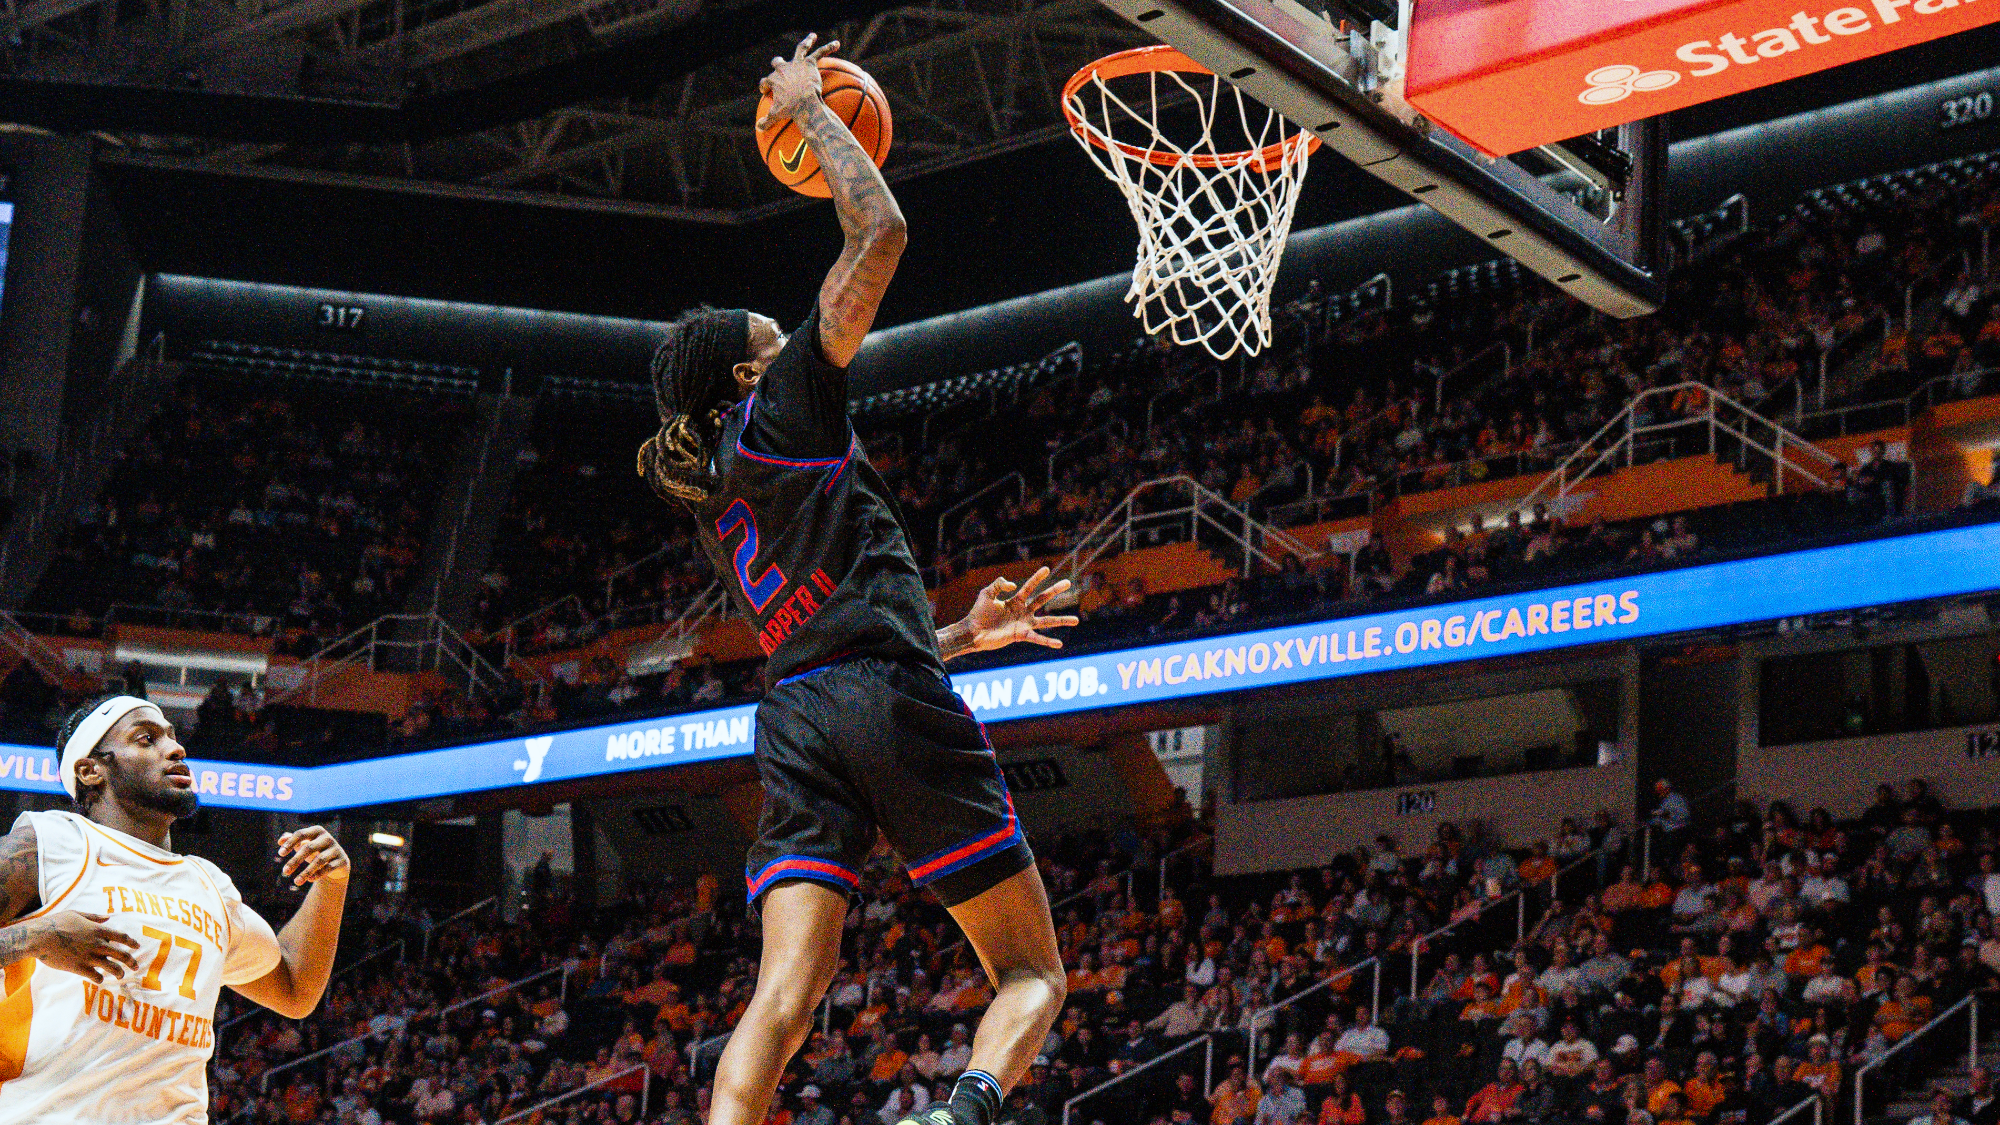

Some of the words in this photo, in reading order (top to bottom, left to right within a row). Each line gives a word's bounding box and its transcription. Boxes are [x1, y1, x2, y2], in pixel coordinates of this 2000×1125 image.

[1676, 5, 1872, 77] State
[1941, 93, 1992, 127] 320
[321, 304, 363, 328] 317
[715, 498, 788, 615] 2
[758, 585, 821, 658] ARPER
[606, 726, 676, 762] MORE
[680, 716, 749, 751] THAN
[952, 678, 1012, 711] HAN
[1017, 675, 1040, 705] A
[1043, 666, 1108, 702] JOB.
[1116, 590, 1639, 691] YMCAKNOXVILLE.ORG/CAREERS
[0, 754, 61, 782] VILL
[1971, 732, 2000, 760] 12
[103, 886, 223, 953] TENNESSEE
[141, 925, 203, 1000] 77
[83, 980, 213, 1049] VOLUNTEERS
